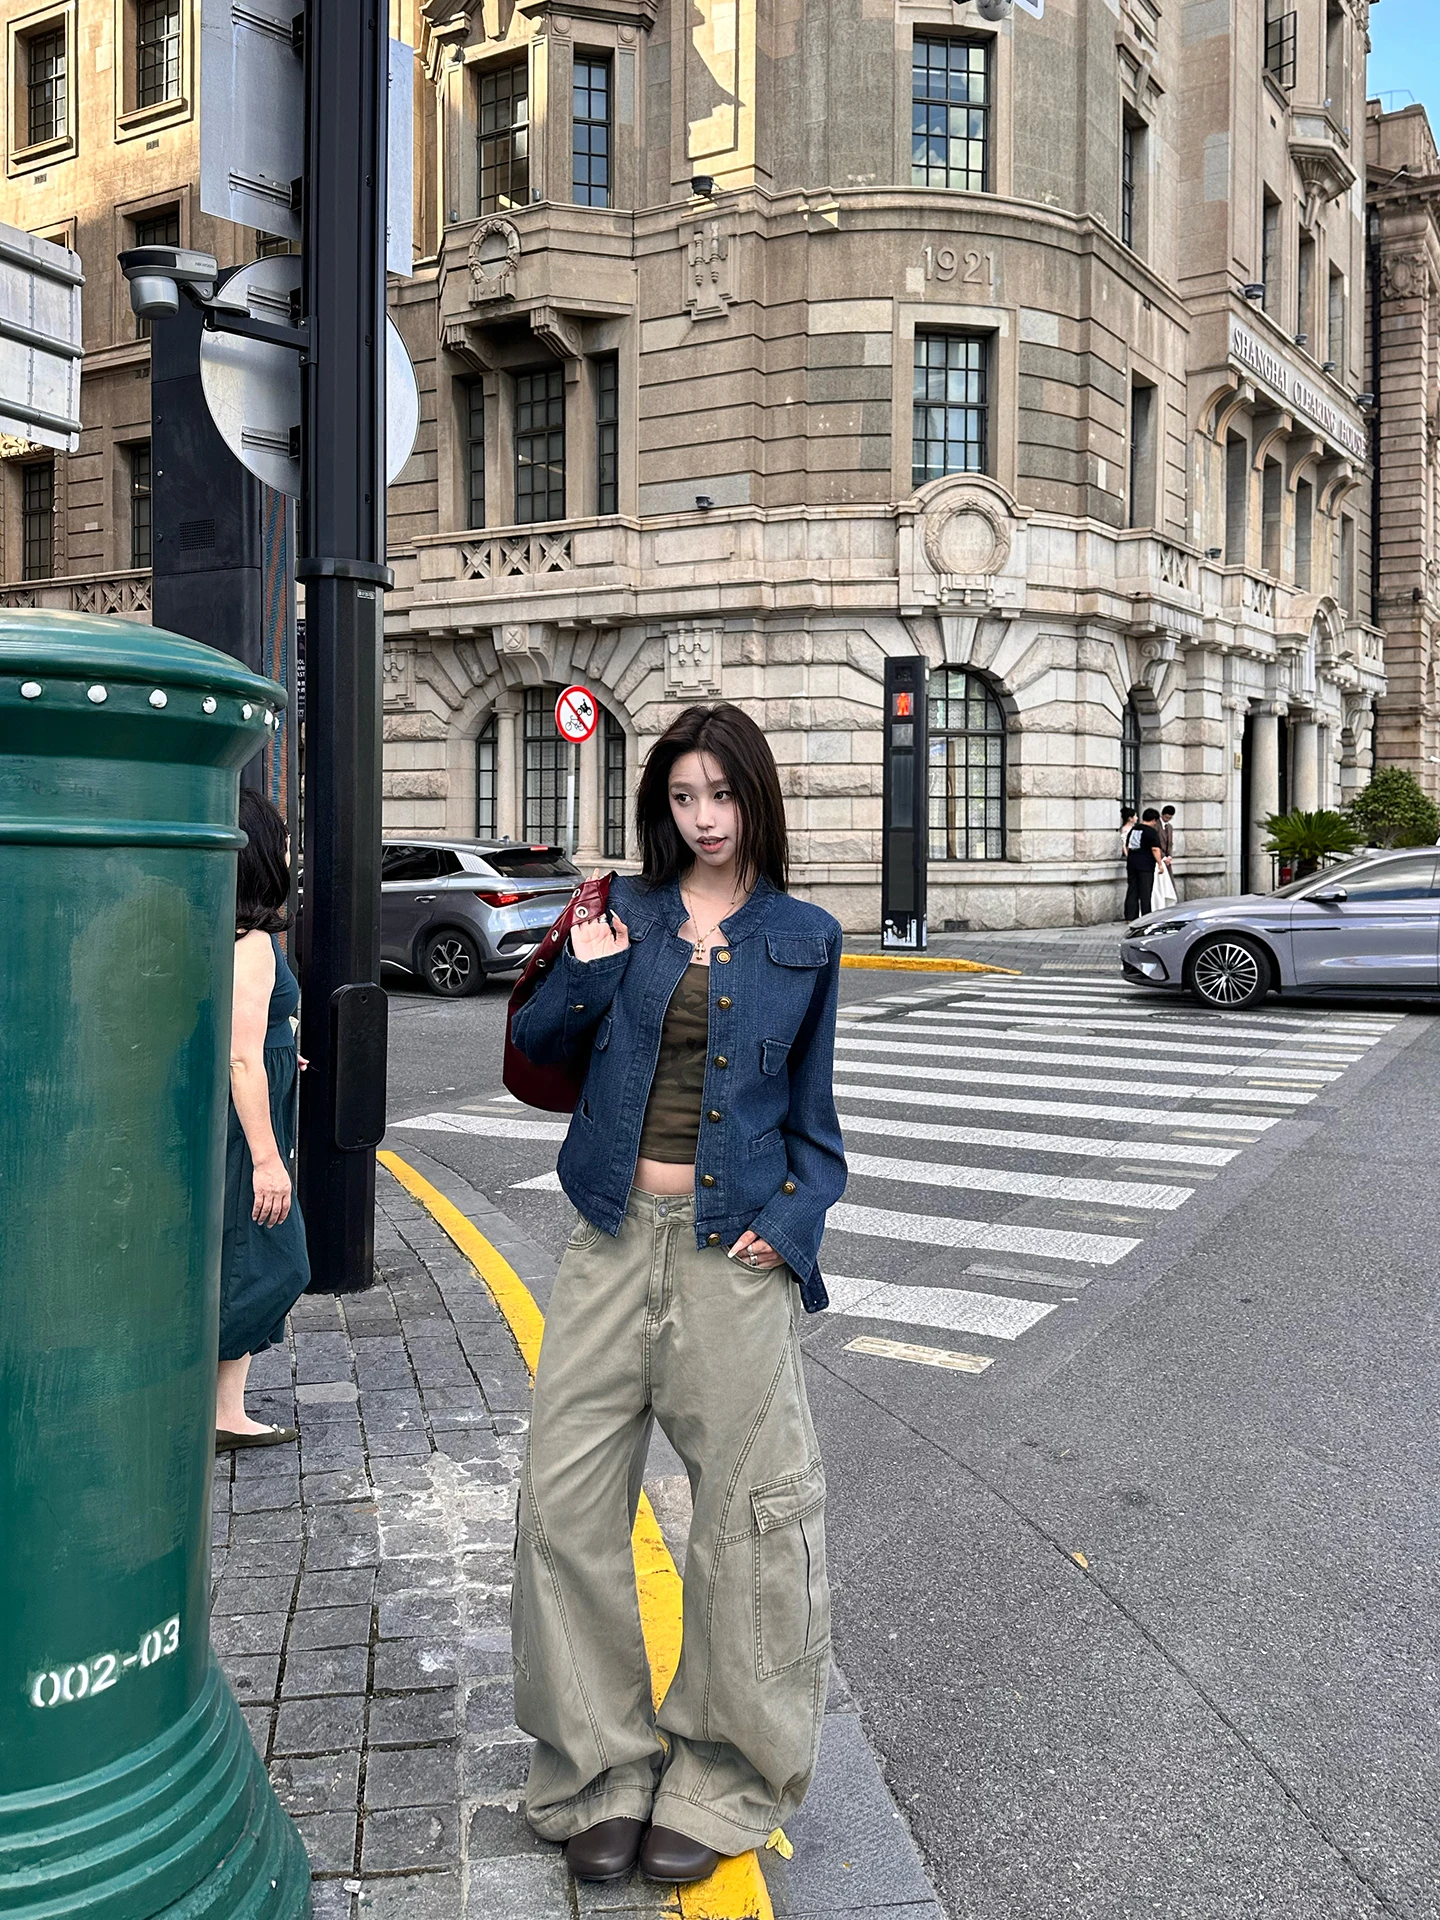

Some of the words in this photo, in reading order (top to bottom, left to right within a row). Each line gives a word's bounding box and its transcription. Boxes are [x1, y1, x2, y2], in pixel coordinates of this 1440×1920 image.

[923, 246, 995, 285] 1921
[1233, 328, 1289, 395] SHANGHAI
[1293, 379, 1337, 434] CLEARING
[1340, 419, 1368, 458] HOUSE
[31, 1617, 180, 1708] 002-03
